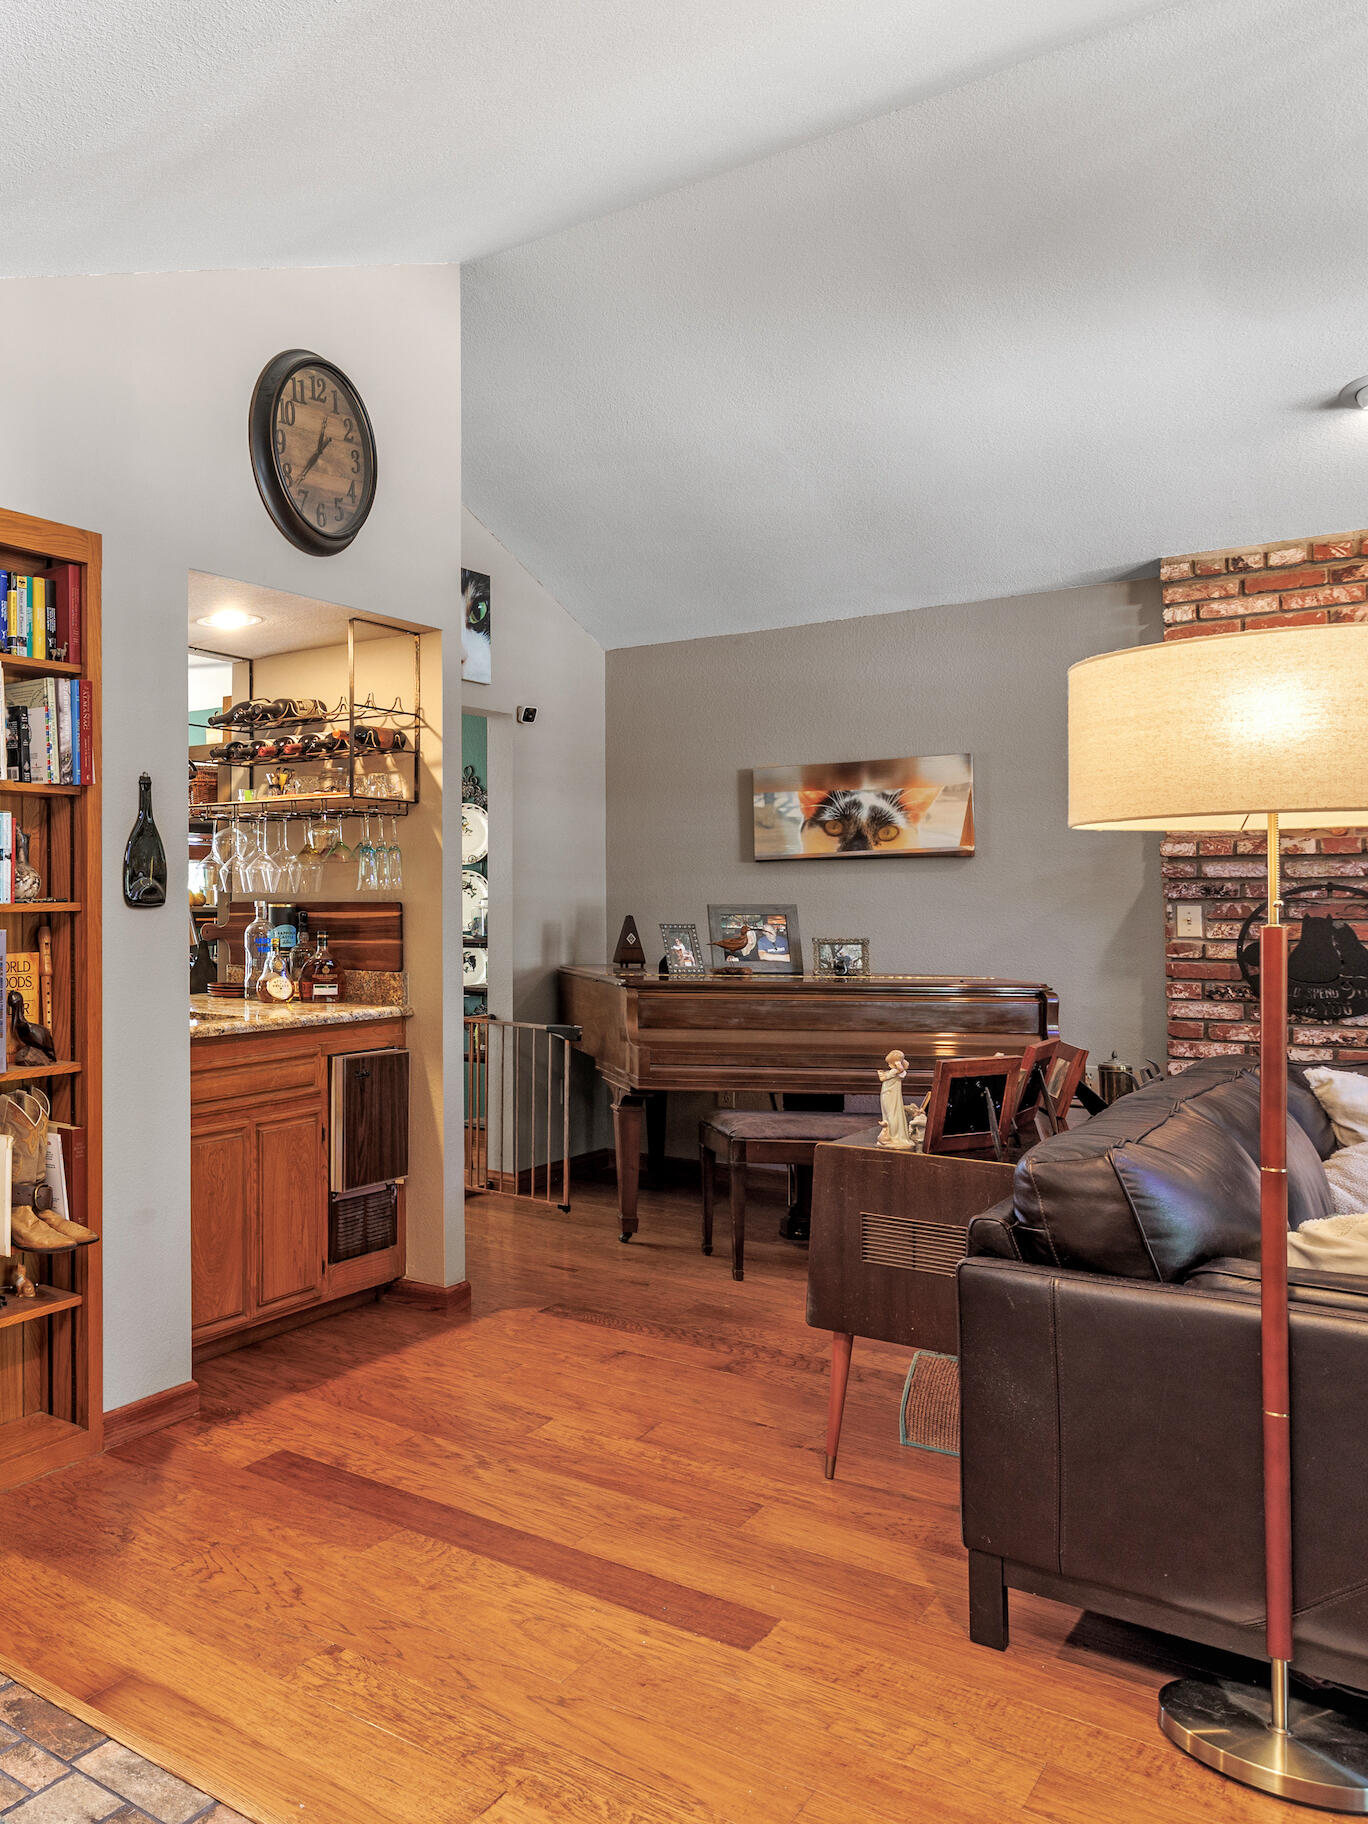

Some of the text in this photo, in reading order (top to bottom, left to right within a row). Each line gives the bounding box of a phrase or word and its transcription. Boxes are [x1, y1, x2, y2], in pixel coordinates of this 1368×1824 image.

[289, 377, 308, 405] 11
[308, 376, 327, 403] 12
[278, 398, 296, 426] 10
[331, 390, 340, 415] 1
[275, 429, 287, 454] 9
[343, 418, 354, 442] 2
[351, 450, 361, 473] 3
[283, 463, 293, 488] 8
[298, 489, 310, 513] 7
[347, 479, 357, 504] 4
[316, 503, 327, 528] 6
[334, 497, 345, 521] 5
[5, 960, 31, 973] ORLD
[1305, 987, 1339, 999] SPEND
